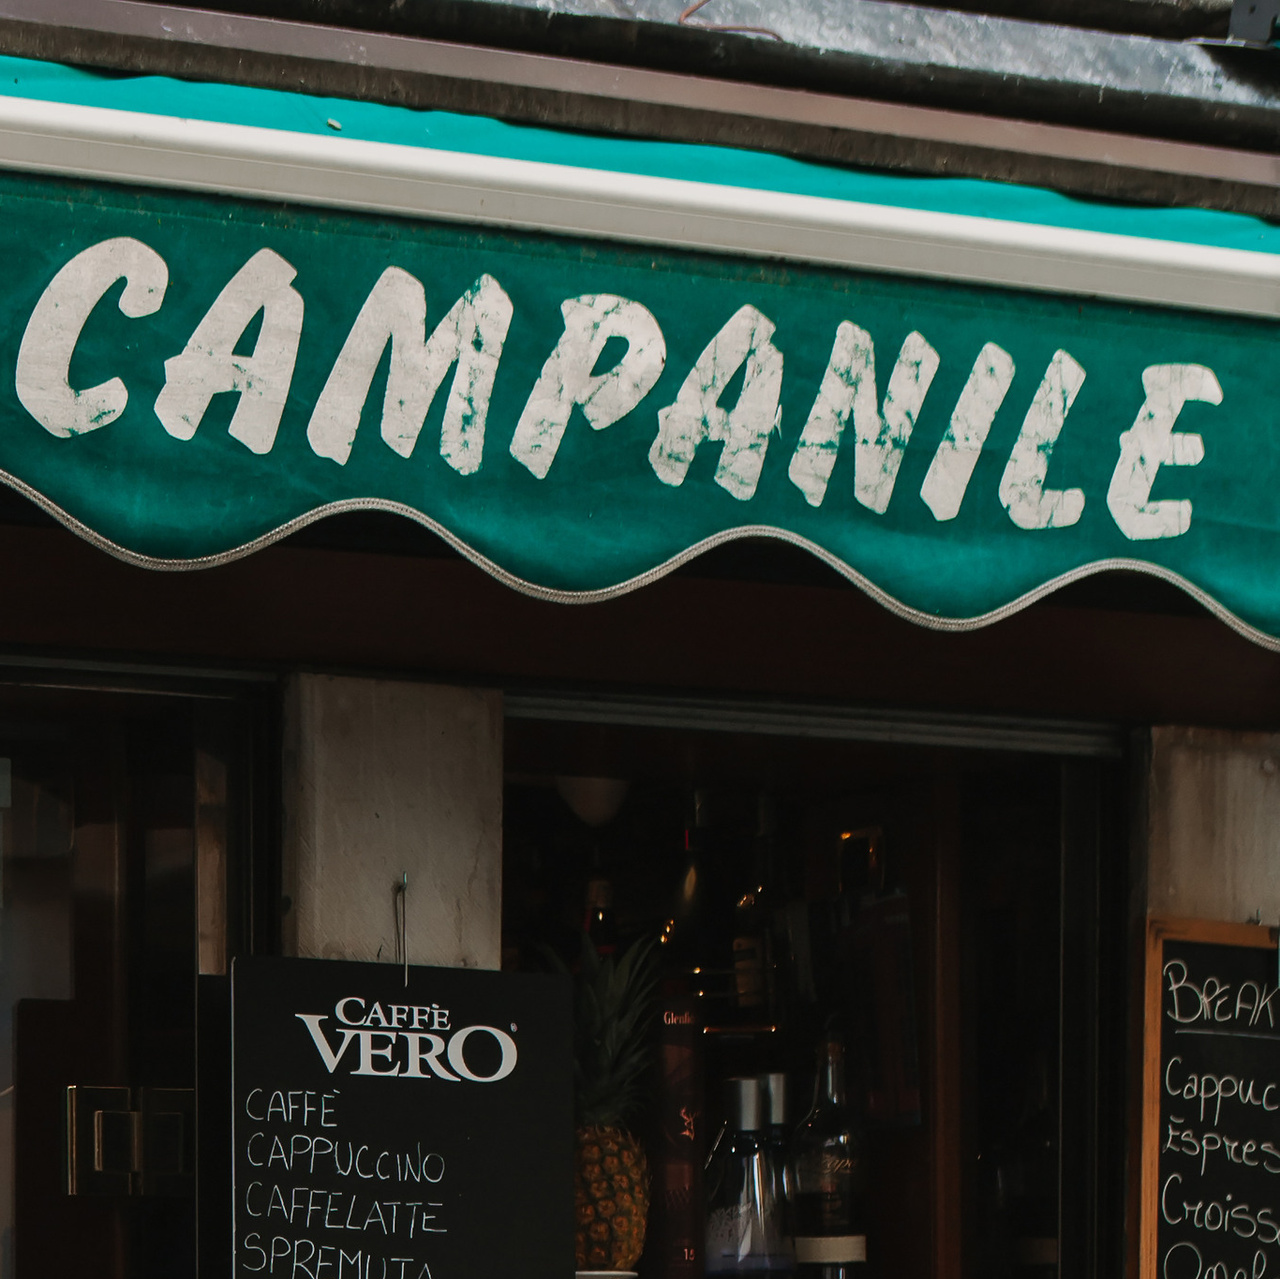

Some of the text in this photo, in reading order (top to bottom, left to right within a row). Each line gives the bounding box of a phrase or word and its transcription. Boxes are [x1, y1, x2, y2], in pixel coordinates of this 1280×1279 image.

[14, 235, 1224, 542] CAMPANILE
[335, 997, 452, 1029] CAFFÈ
[295, 1013, 518, 1083] VERO
[245, 1088, 340, 1128] CAFFÈ
[1165, 1056, 1280, 1126] Cappuc
[246, 1132, 446, 1184] CAPPUCCINO
[245, 1181, 448, 1239] CAFFELATTE
[1162, 1173, 1280, 1244] Croiss
